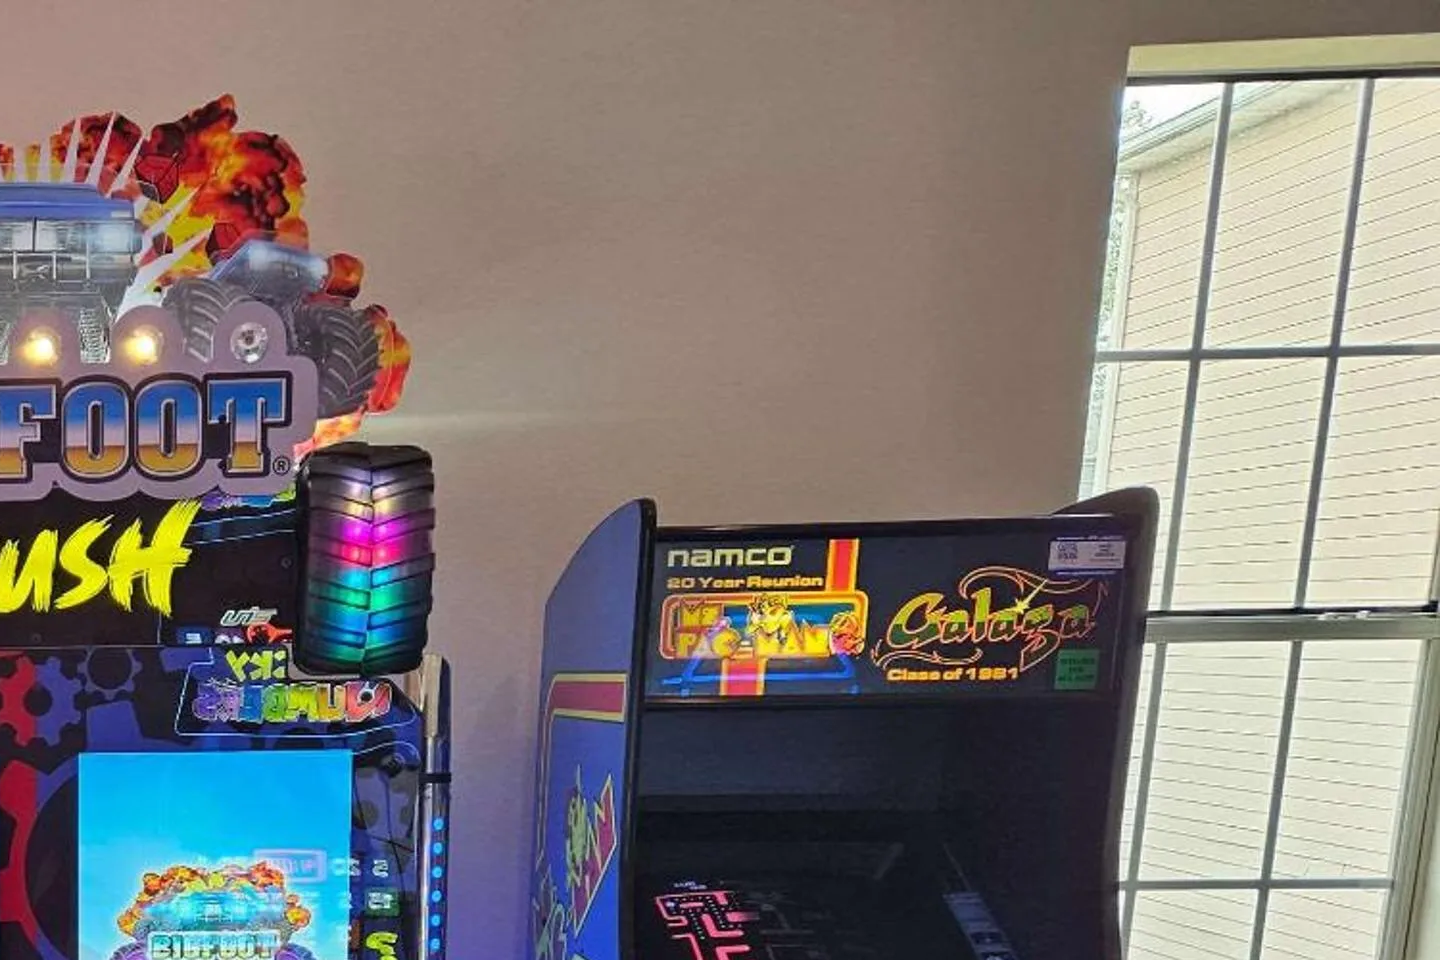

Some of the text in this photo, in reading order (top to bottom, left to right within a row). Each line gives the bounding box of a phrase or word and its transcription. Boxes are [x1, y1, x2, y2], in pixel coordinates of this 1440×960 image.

[667, 546, 793, 568] namco
[667, 575, 824, 589] 20 Year Reunion
[886, 587, 1096, 672] Galaga
[887, 668, 941, 681] Class
[943, 667, 964, 681] of
